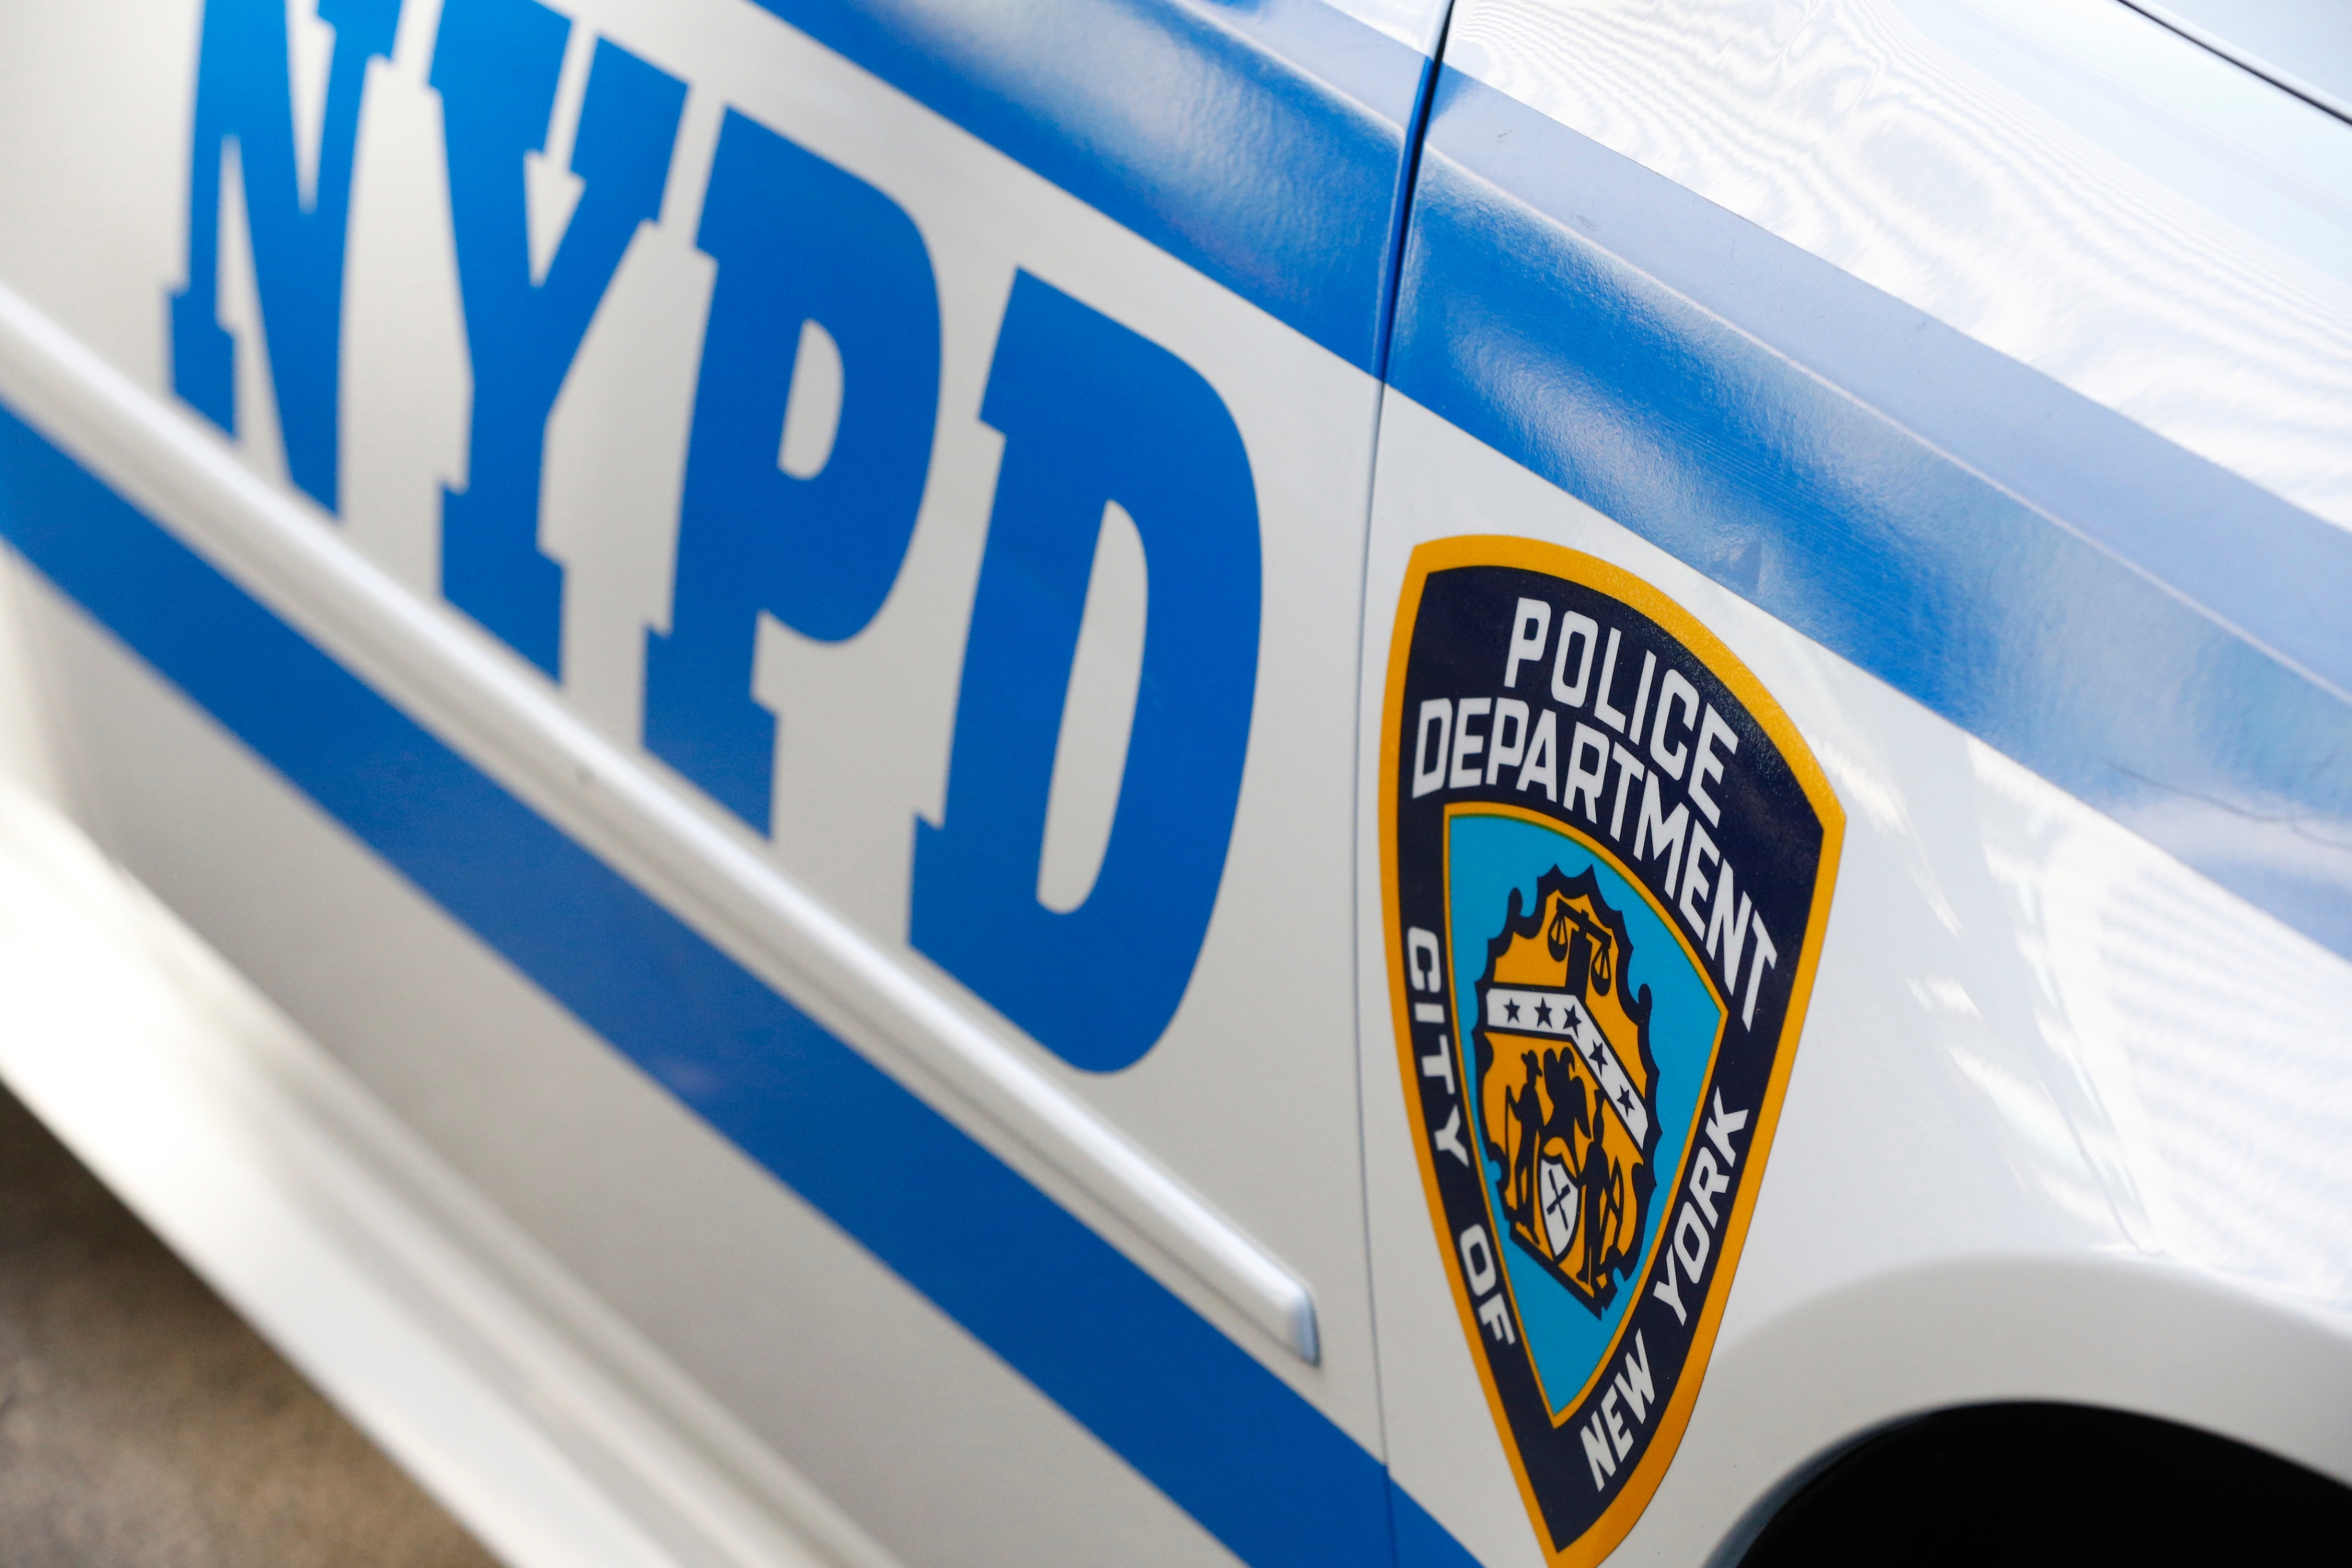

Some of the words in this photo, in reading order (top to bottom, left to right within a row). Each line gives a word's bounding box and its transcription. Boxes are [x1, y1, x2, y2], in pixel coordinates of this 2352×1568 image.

[165, 0, 1263, 1075] NYPD
[1504, 597, 1738, 828] POLICE
[1412, 697, 1777, 1032] DEPARTMENT
[1408, 926, 1470, 1168] CITY
[1460, 1223, 1517, 1346] OF
[1579, 1329, 1656, 1492] NEW
[1653, 1086, 1748, 1325] YORK
